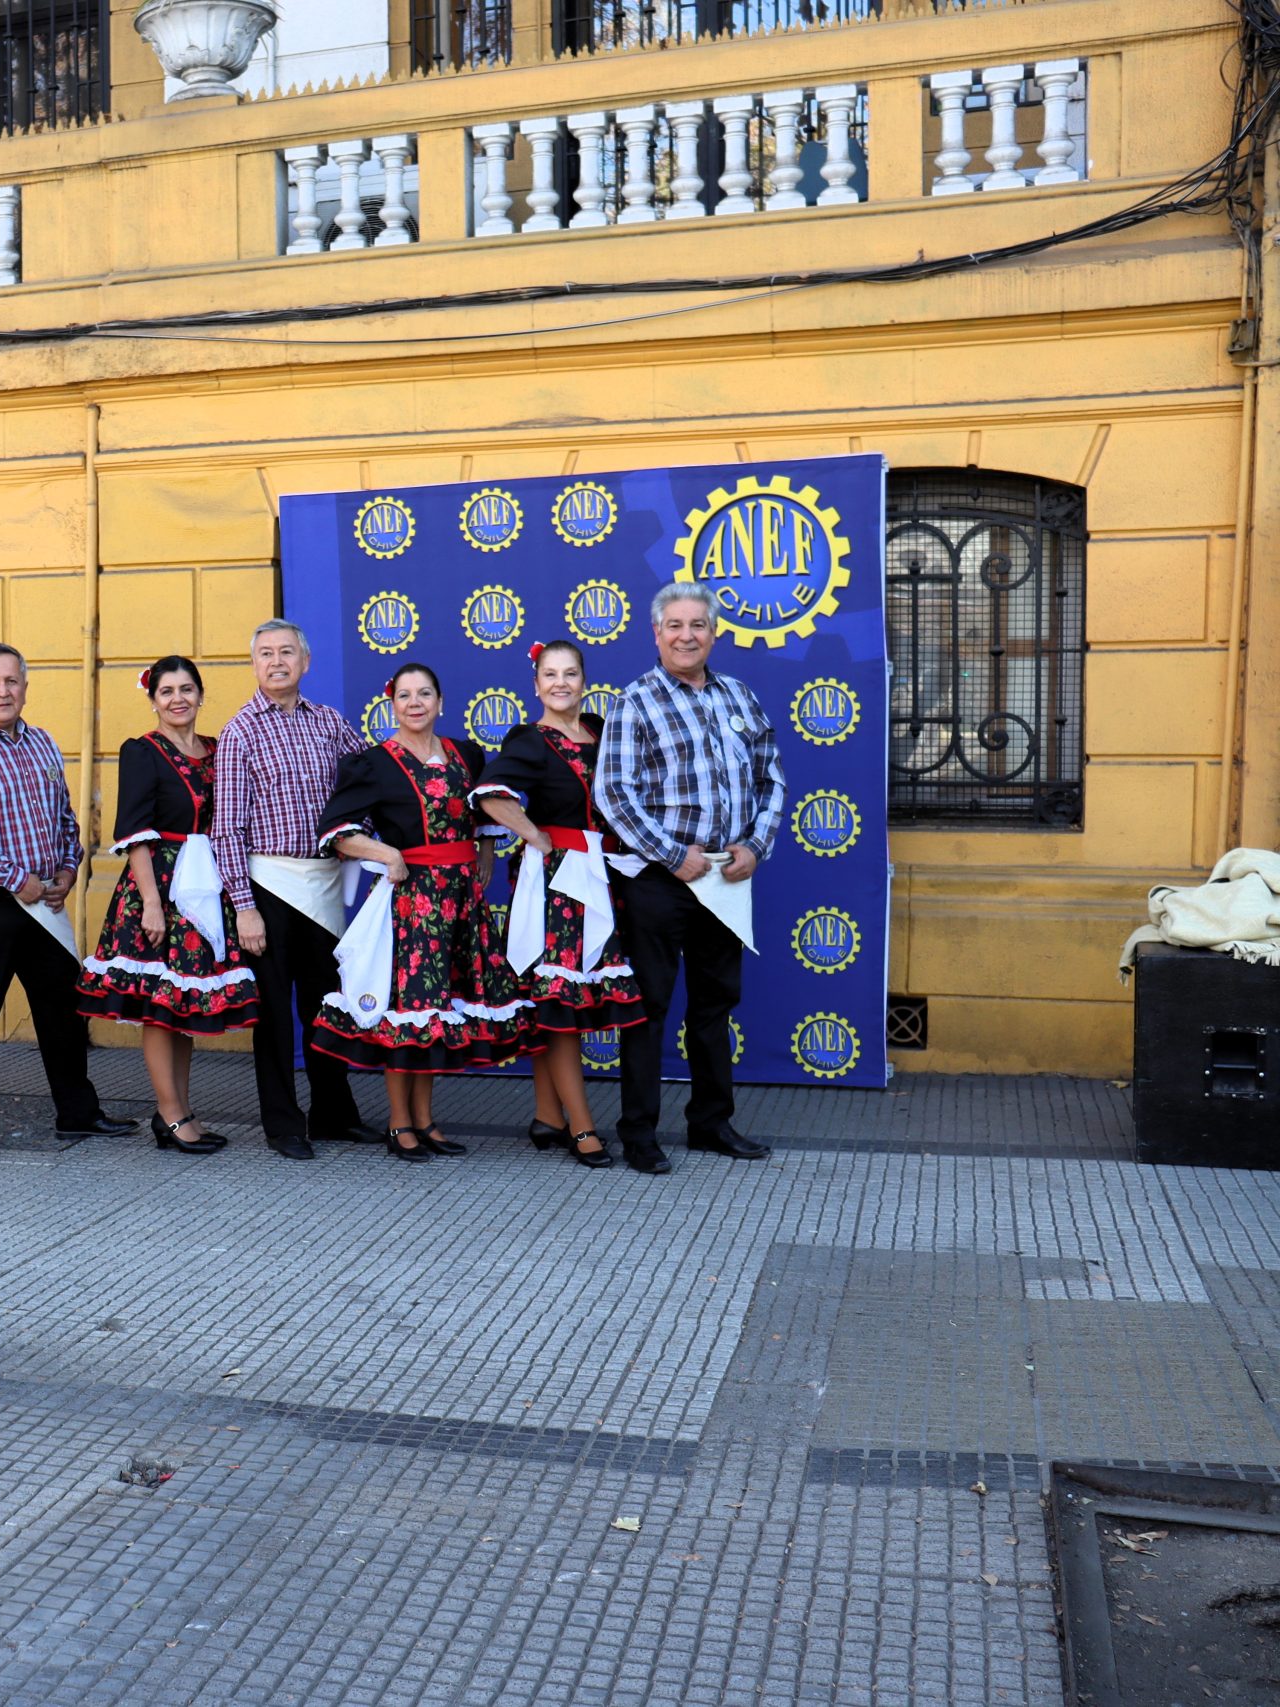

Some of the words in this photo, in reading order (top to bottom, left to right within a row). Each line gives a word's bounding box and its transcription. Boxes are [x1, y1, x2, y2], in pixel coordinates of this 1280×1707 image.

[363, 504, 404, 535] ANEF
[468, 496, 511, 528] ANEF
[561, 489, 605, 522] ANEF
[368, 535, 404, 550] CHILE
[474, 527, 510, 542] CHILE
[567, 520, 604, 536] CHILE
[698, 498, 815, 579] ANEF
[366, 599, 408, 630] ANEF
[470, 594, 512, 624] ANEF
[574, 586, 618, 619] ANEF
[716, 582, 816, 622] CHILE
[372, 630, 407, 645] CHILE
[476, 624, 512, 640] CHILE
[580, 619, 617, 635] CHILE
[370, 701, 401, 730] AN
[473, 696, 515, 727] ANEF
[581, 692, 609, 720] ANE
[800, 686, 847, 719] ANEF
[806, 720, 847, 736] CHILE
[801, 798, 848, 830] ANEF
[808, 831, 848, 847] CHILE
[801, 915, 848, 947] ANEF
[807, 947, 847, 964] CHILE
[800, 1020, 847, 1052] ANEF
[807, 1052, 847, 1069] CHILE
